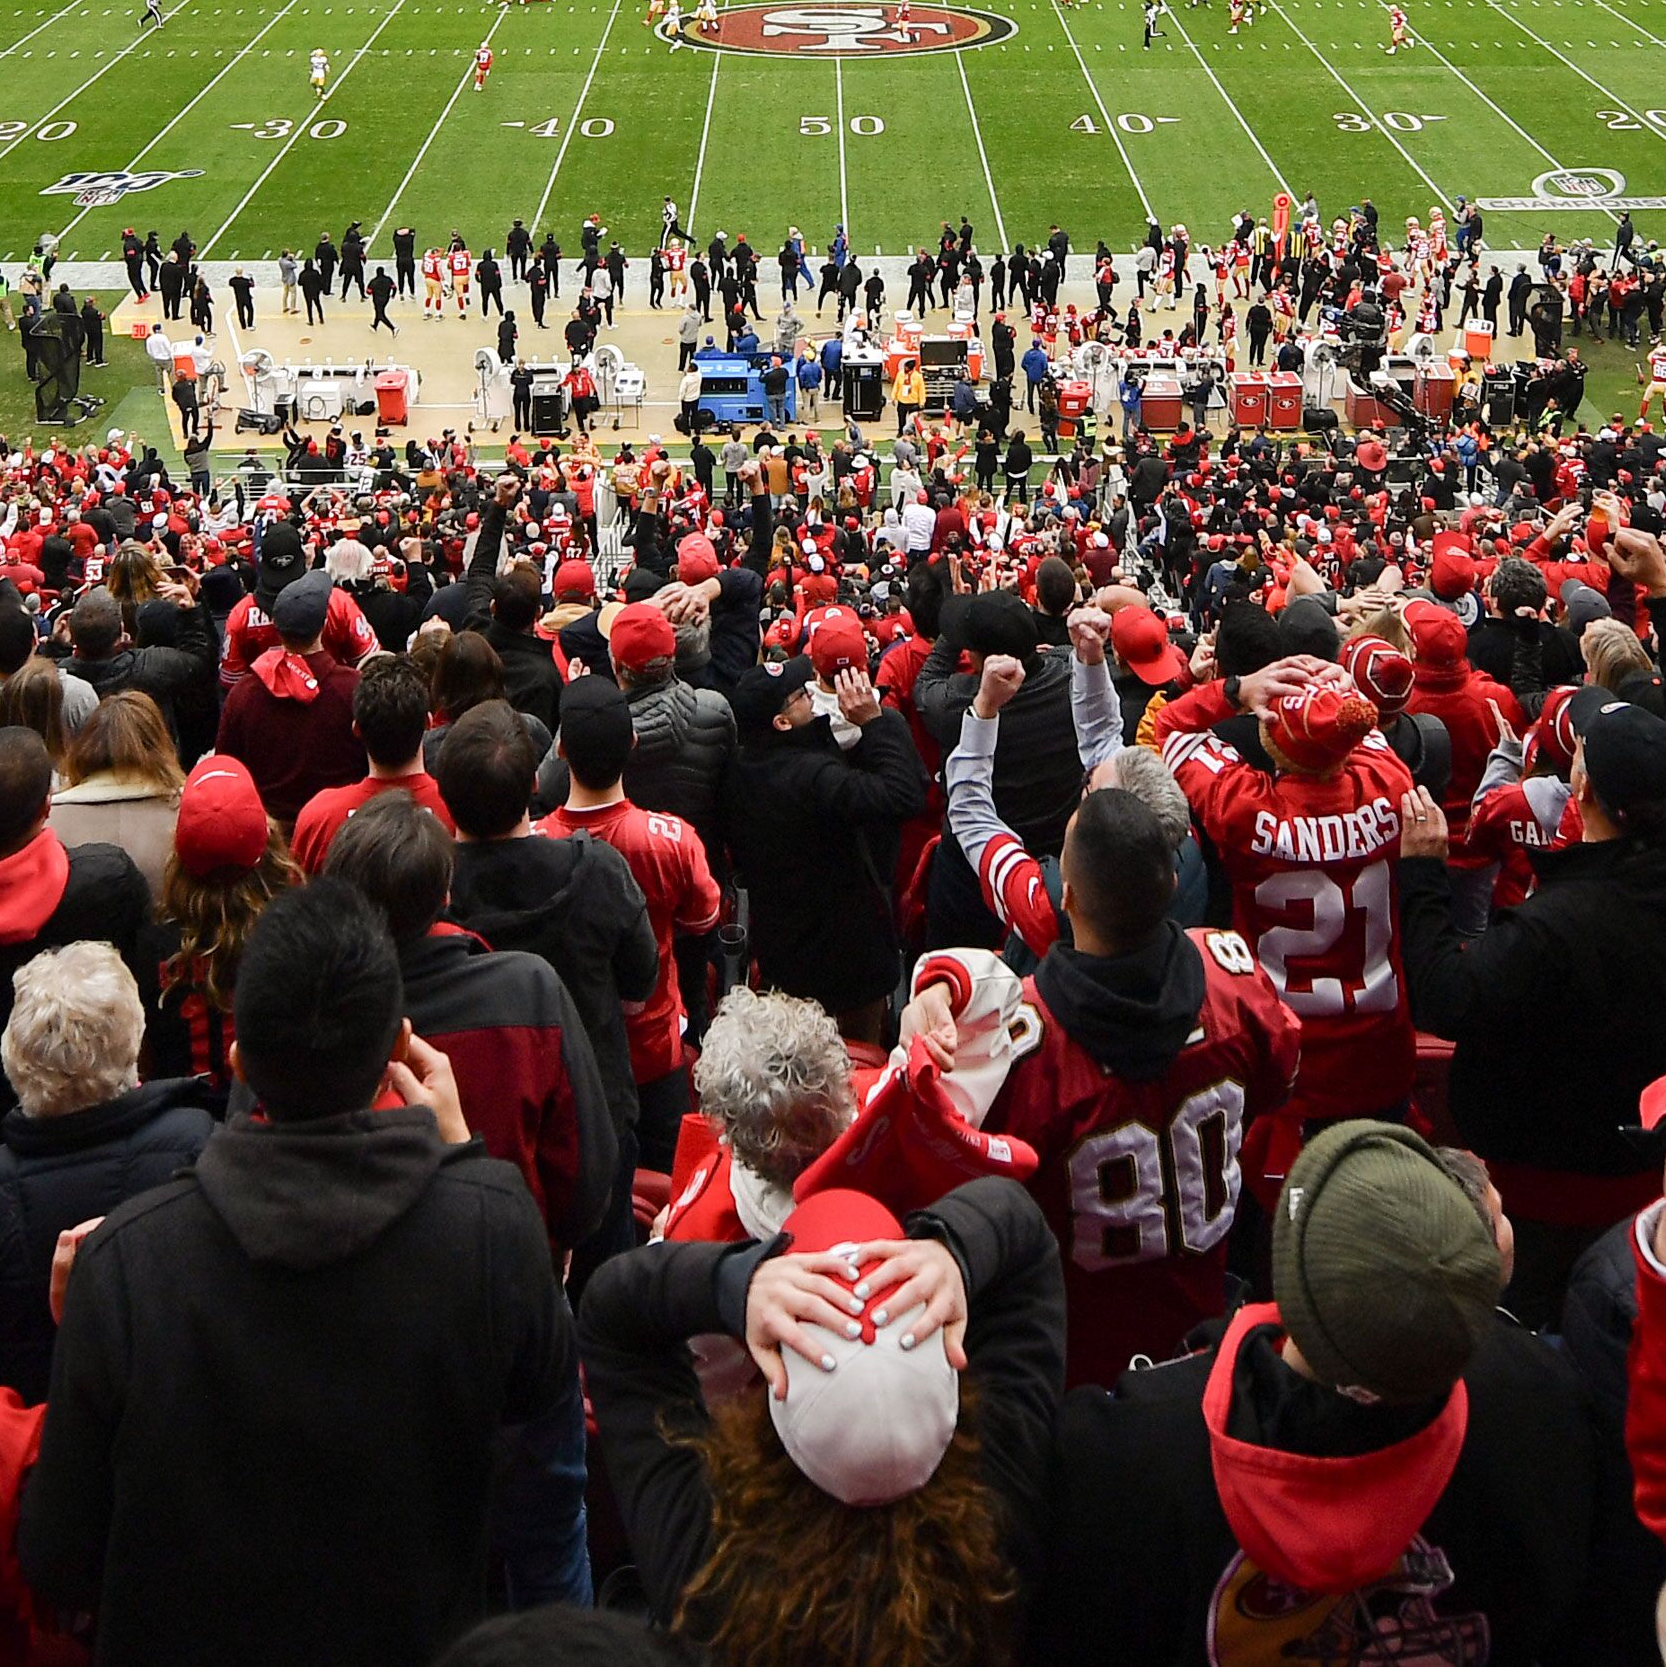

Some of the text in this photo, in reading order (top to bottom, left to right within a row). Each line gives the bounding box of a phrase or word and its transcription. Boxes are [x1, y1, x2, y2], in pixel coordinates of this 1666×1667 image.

[133, 324, 145, 337] 30
[350, 453, 366, 466] 25
[85, 565, 103, 581] 53
[1251, 796, 1400, 862] SANDERS
[1254, 858, 1399, 1017] 21
[1068, 1077, 1245, 1273] 80
